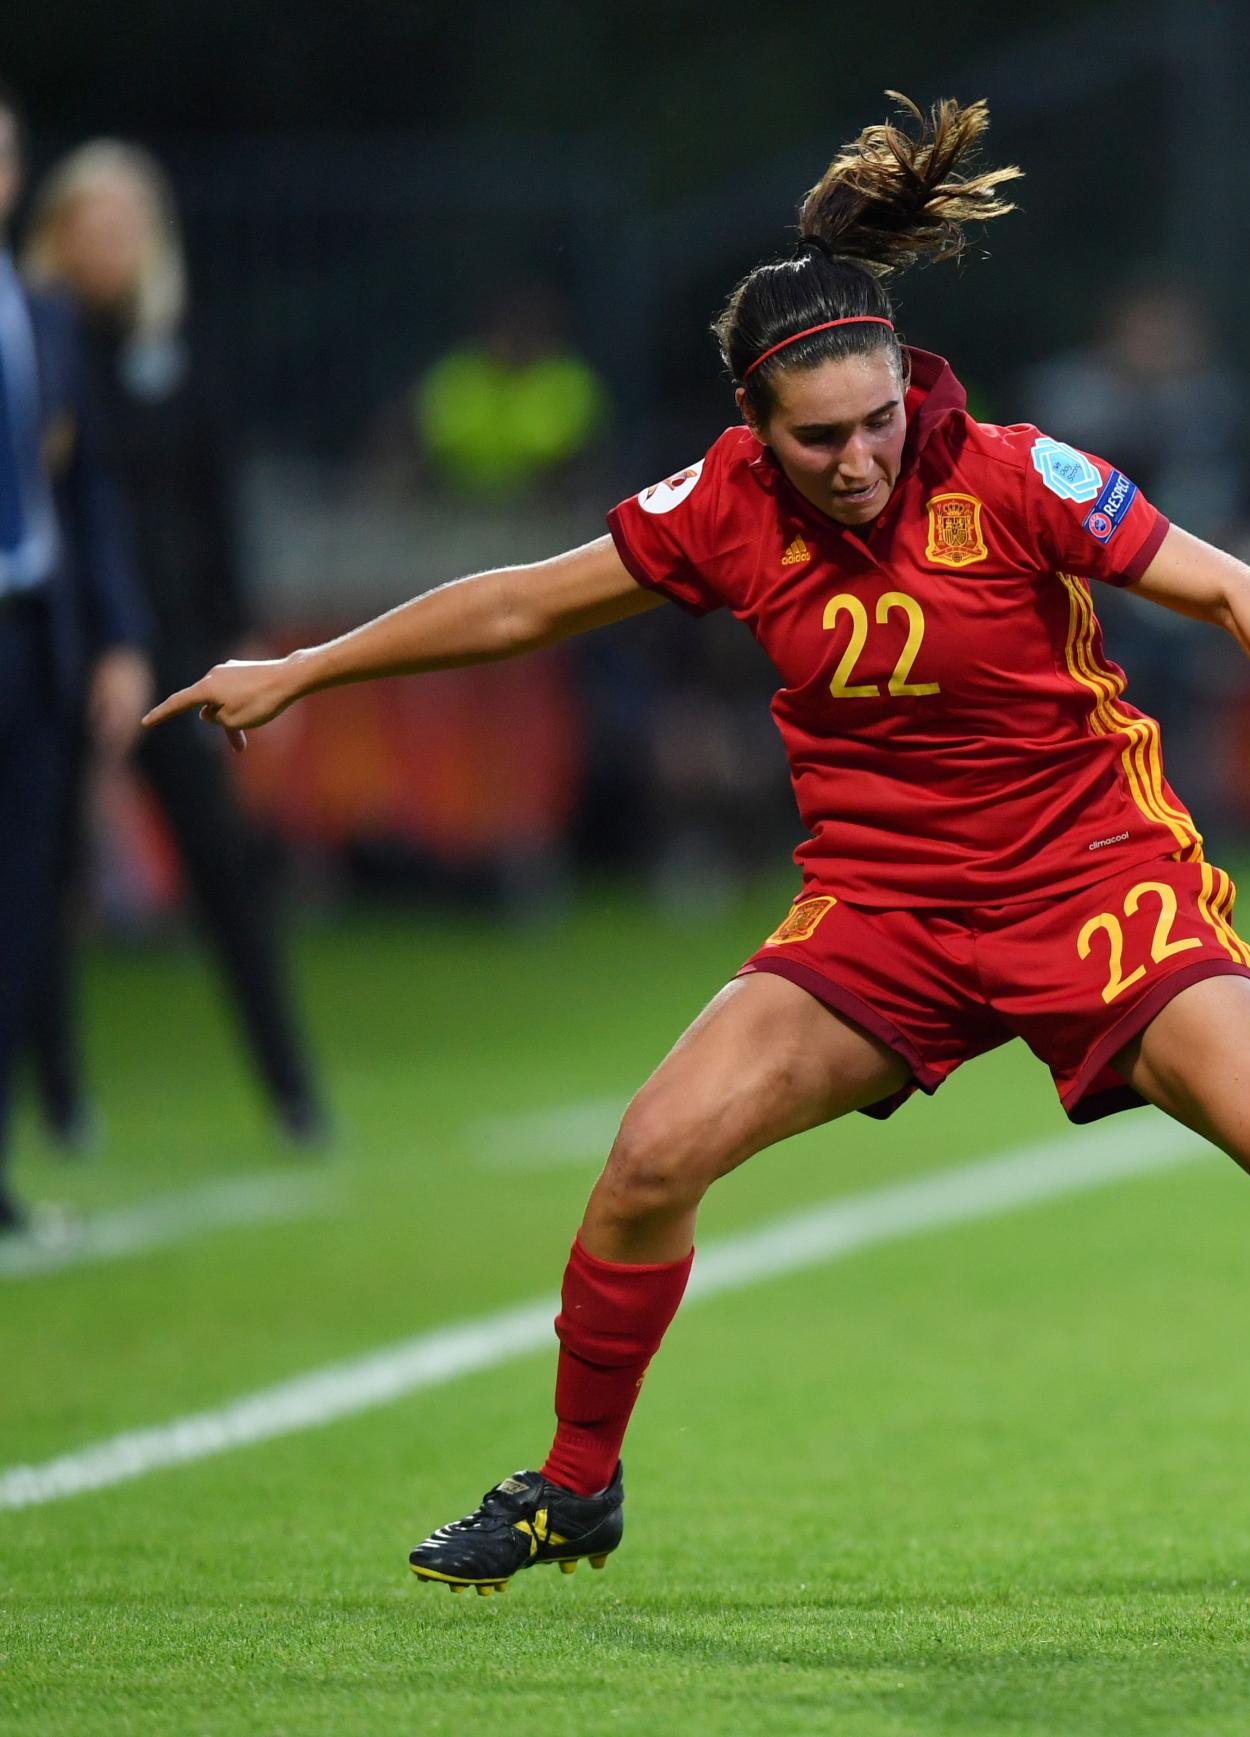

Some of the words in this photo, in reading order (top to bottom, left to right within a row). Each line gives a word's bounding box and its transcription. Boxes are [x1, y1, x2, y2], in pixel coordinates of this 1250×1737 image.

[1103, 475, 1130, 517] RESPECT
[782, 551, 810, 565] adidas
[823, 592, 940, 698] 22
[1088, 831, 1129, 850] climacool
[1077, 882, 1203, 1004] 22
